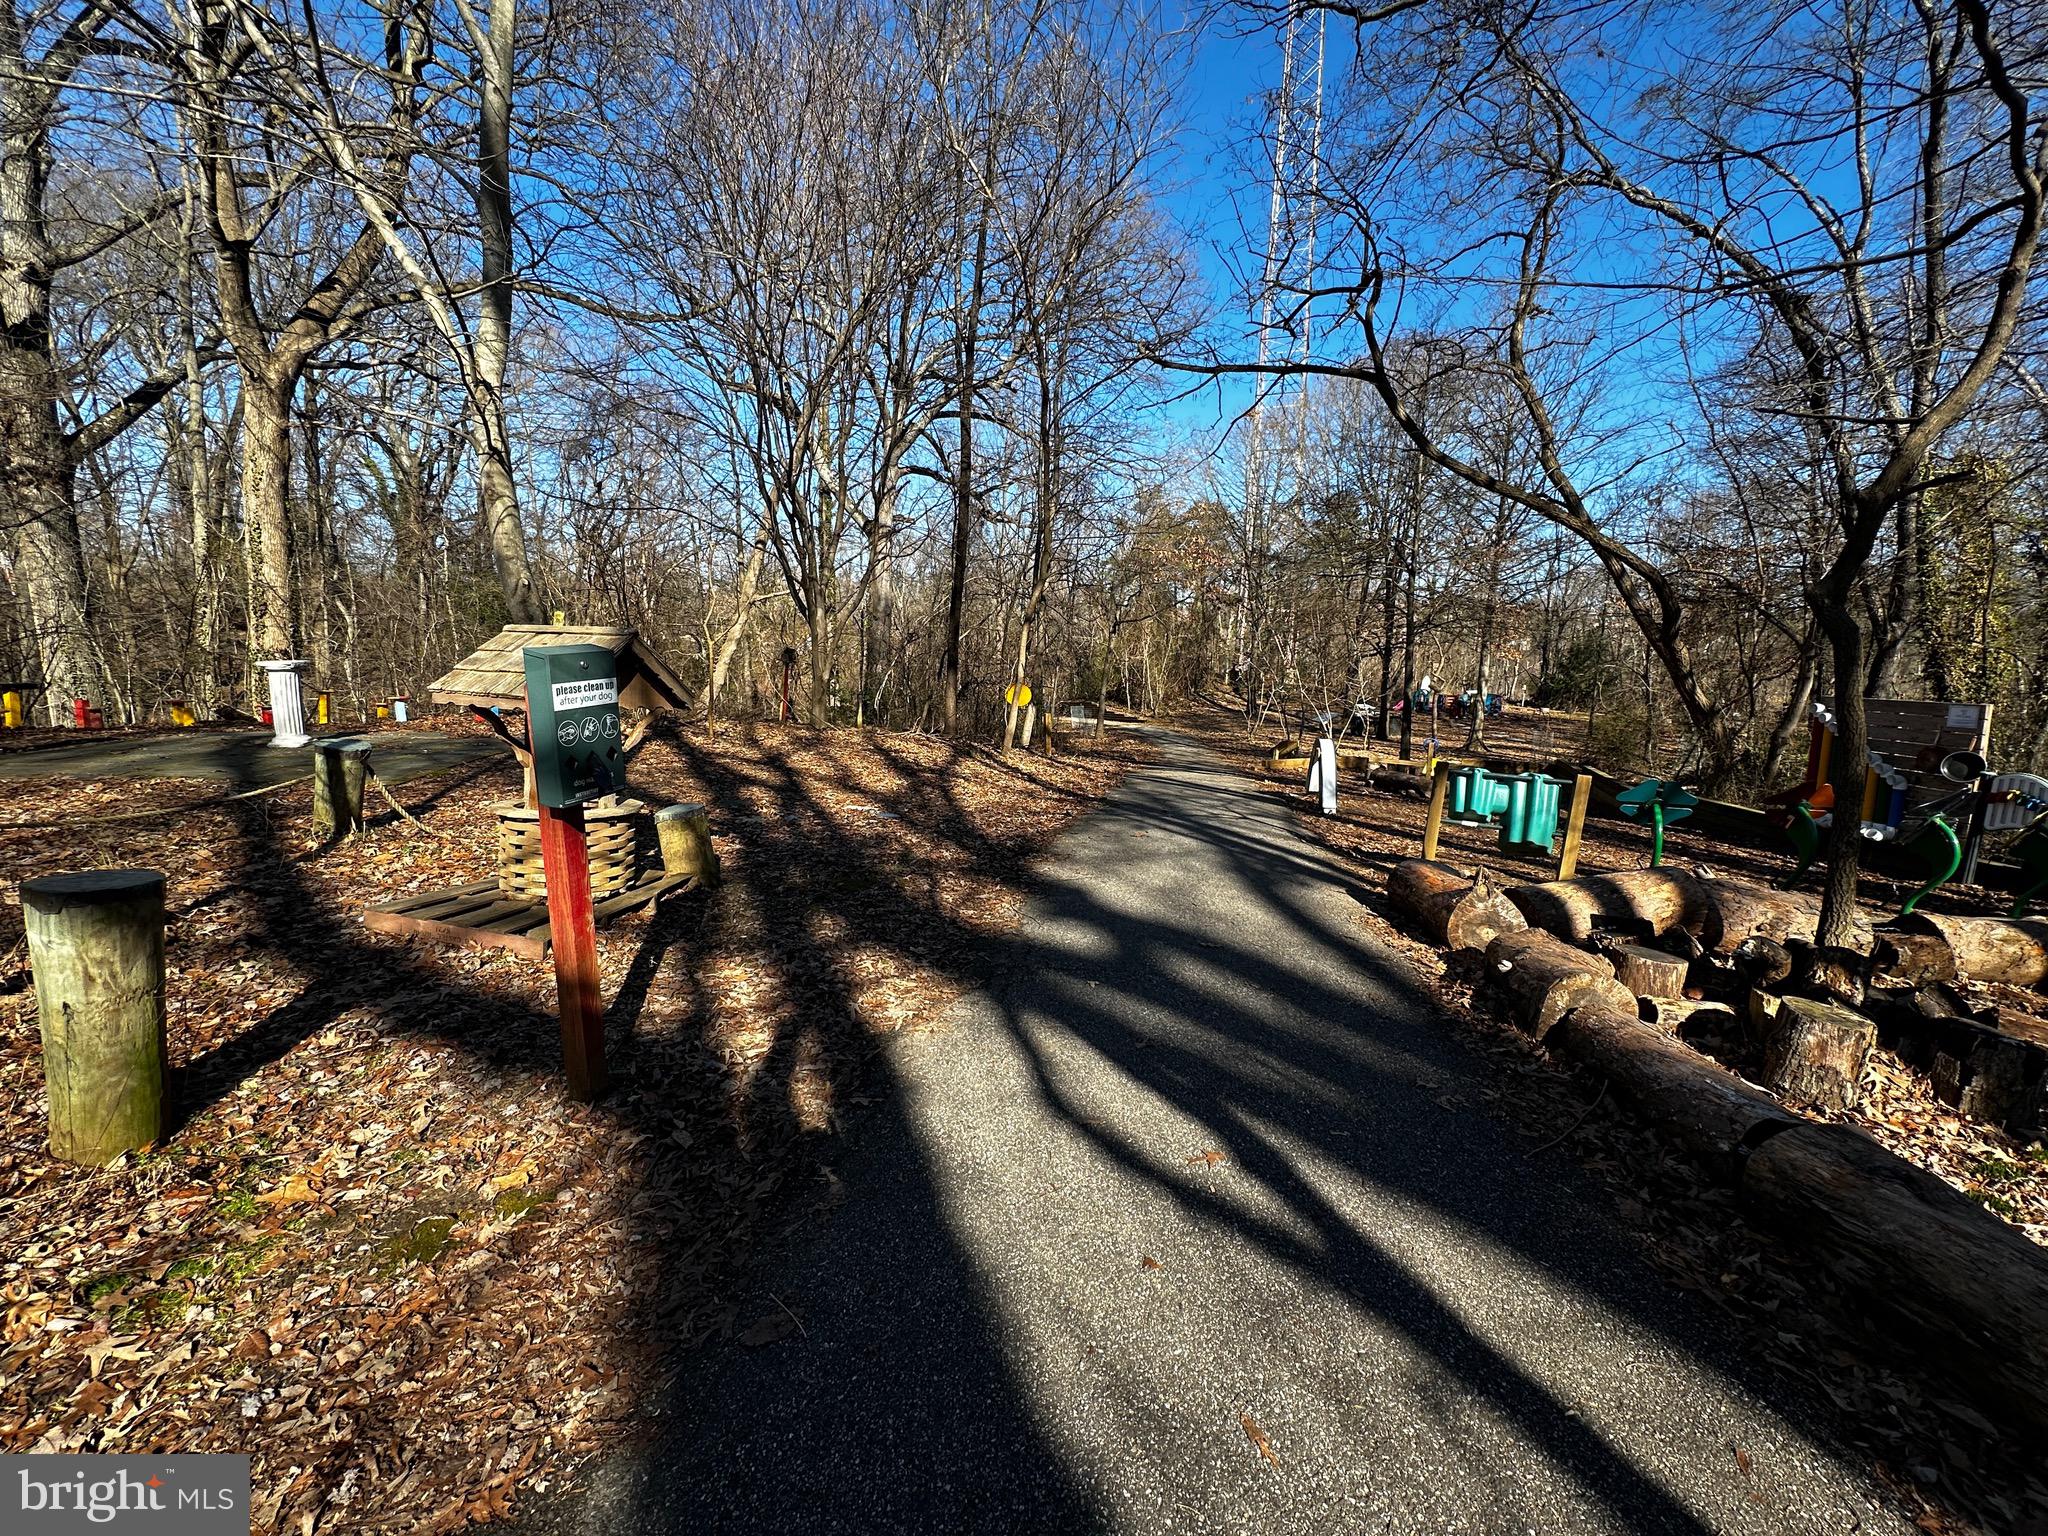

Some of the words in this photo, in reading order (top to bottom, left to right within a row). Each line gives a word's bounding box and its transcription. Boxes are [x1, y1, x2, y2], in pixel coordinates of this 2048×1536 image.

[556, 684, 582, 696] please
[583, 682, 604, 692] clean
[605, 681, 615, 690] up
[560, 695, 578, 705] after
[580, 694, 597, 705] your
[598, 691, 613, 701] dog
